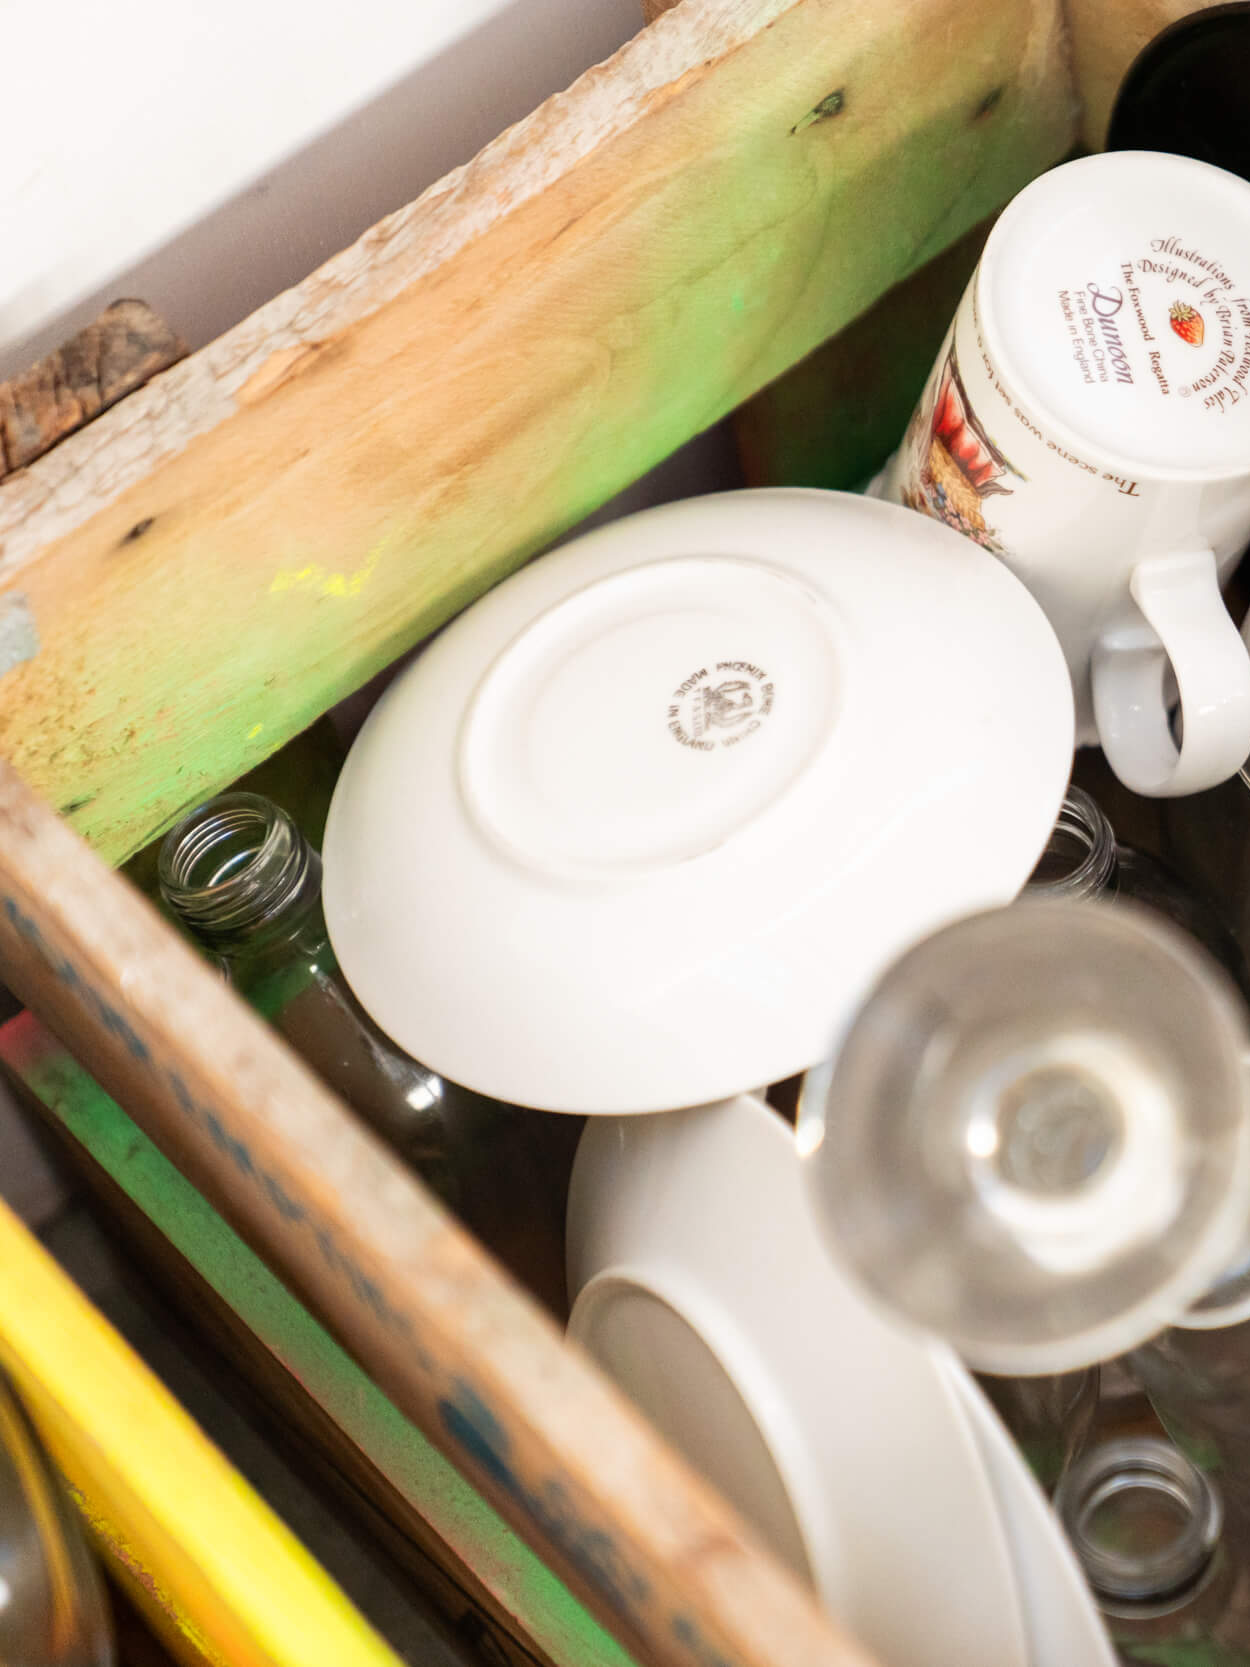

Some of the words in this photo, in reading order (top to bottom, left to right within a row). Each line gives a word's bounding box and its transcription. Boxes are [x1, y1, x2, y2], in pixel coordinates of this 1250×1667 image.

[1137, 258, 1213, 288] Designed
[1057, 290, 1075, 322] Made
[1200, 287, 1225, 307] by
[1068, 324, 1079, 336] in
[1074, 290, 1088, 315] Fine
[1082, 317, 1098, 347] Bone
[1092, 348, 1108, 383] China
[1086, 282, 1135, 385] Dunoon
[1120, 261, 1134, 285] The
[1127, 287, 1156, 342] Foxwood
[1148, 350, 1170, 396] Regatta
[1150, 236, 1236, 291] Illustrations
[1203, 386, 1241, 414] Tales
[1216, 302, 1238, 347] Brian
[1072, 338, 1097, 385] England
[1192, 349, 1235, 393] Paterson
[1013, 407, 1043, 441] was
[1046, 440, 1099, 475] scene
[1102, 472, 1141, 497] The
[672, 667, 709, 697] MADE
[667, 704, 679, 718] IN
